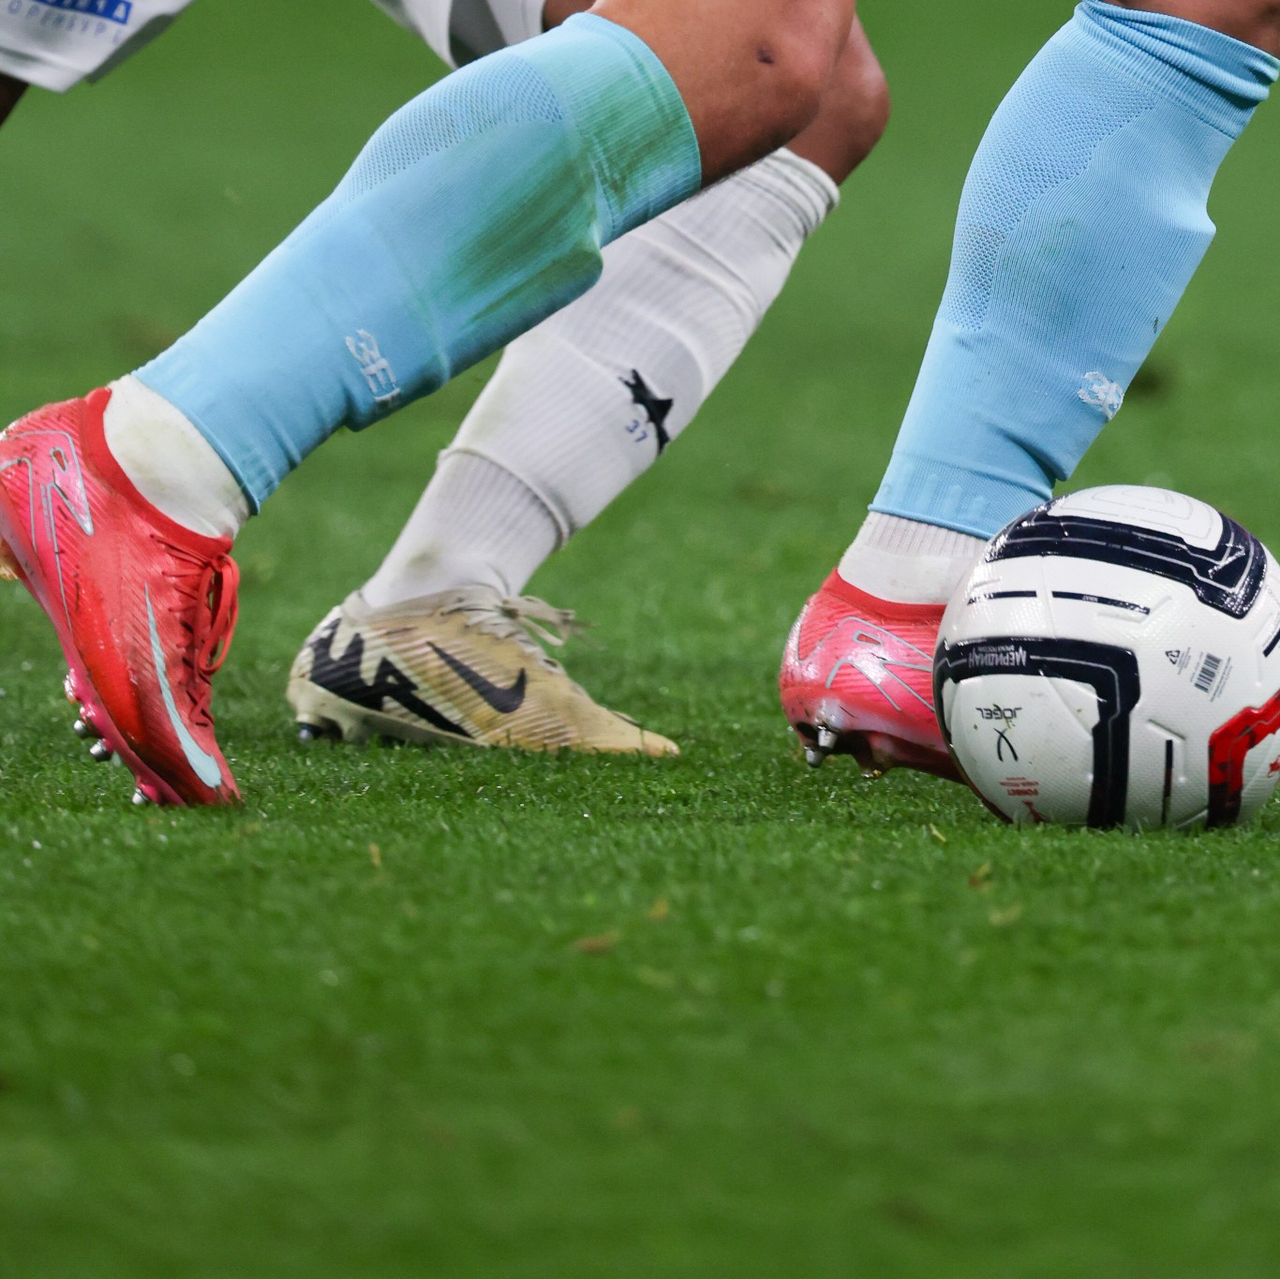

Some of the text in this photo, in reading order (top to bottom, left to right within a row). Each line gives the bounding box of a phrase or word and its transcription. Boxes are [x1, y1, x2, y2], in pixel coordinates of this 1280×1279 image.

[625, 419, 649, 443] 37
[968, 644, 1028, 669] МЕРИДИАН
[975, 707, 1023, 721] JOGEL
